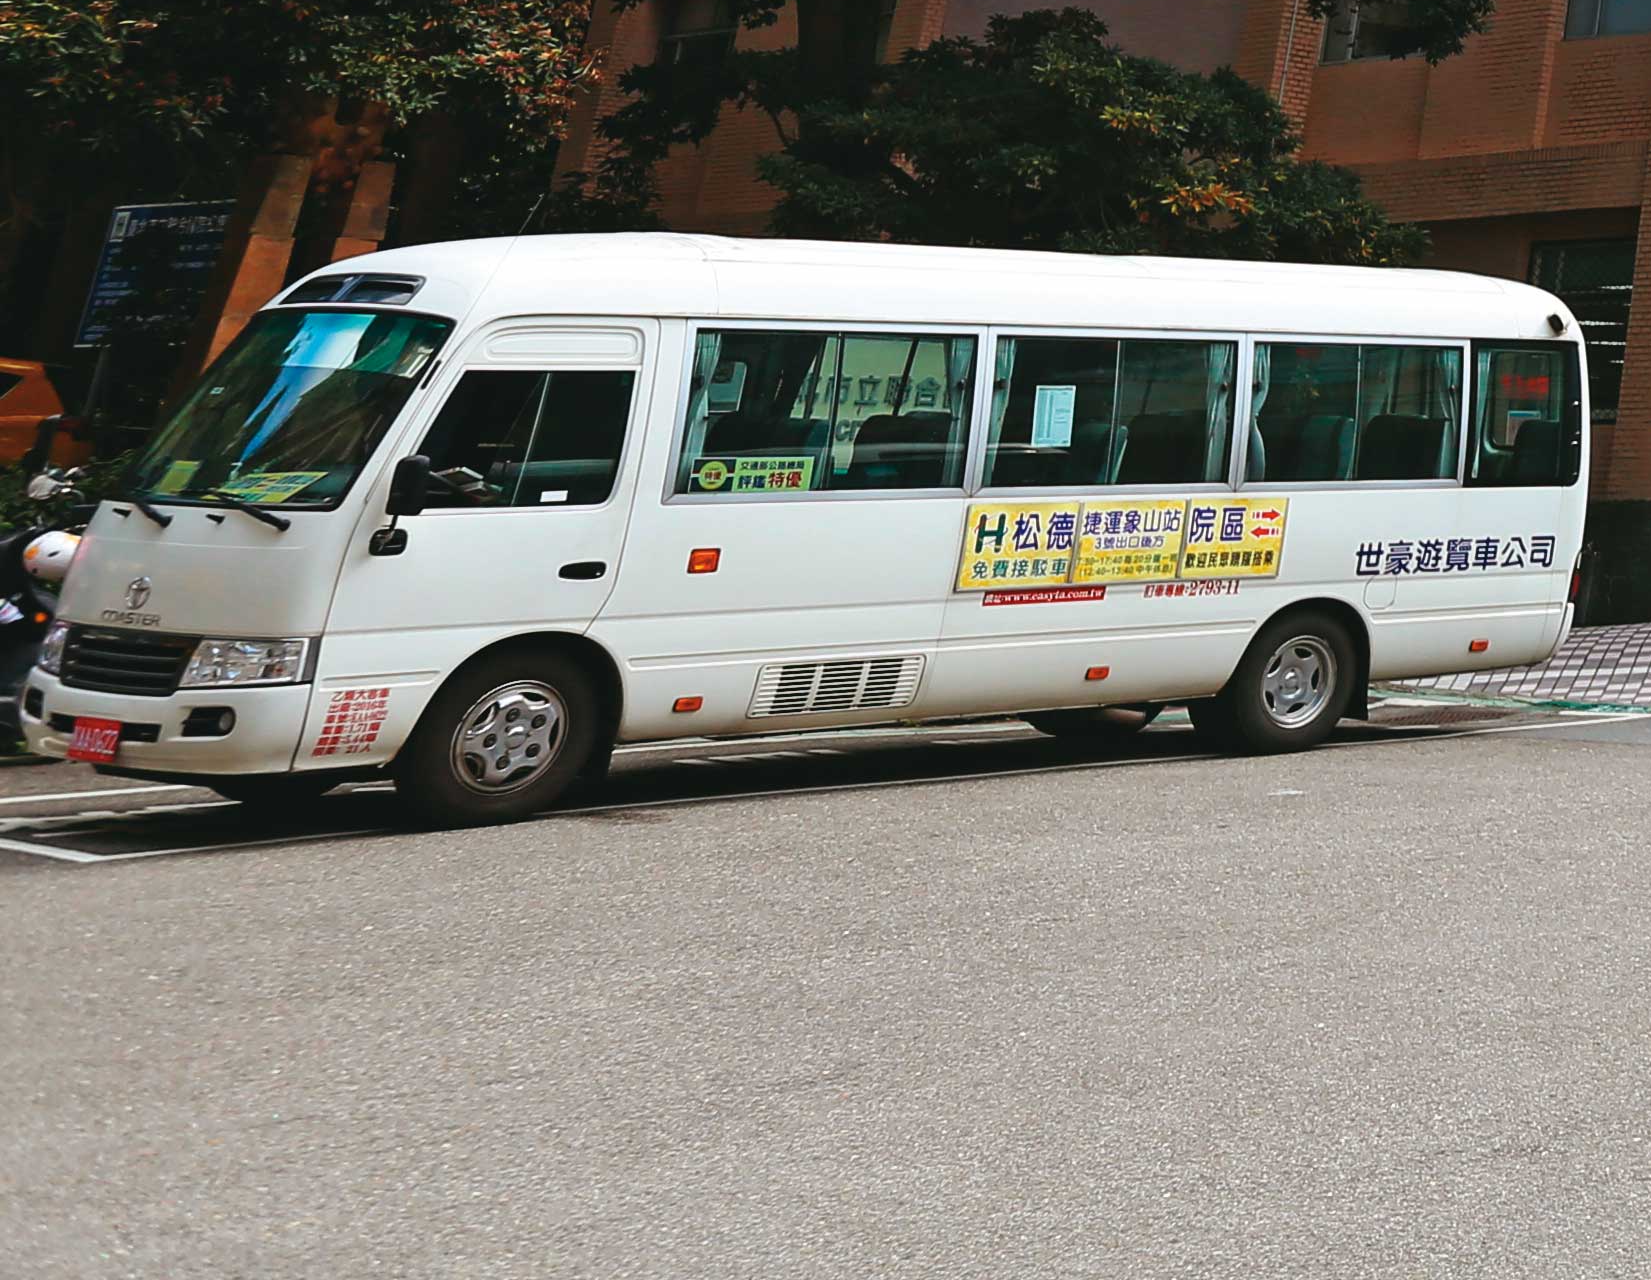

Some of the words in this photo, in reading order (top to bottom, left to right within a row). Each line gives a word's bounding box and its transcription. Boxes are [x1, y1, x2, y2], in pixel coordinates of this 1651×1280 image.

[1012, 512, 1076, 552] 松德
[1082, 509, 1181, 536] 捷運象山站
[1188, 506, 1247, 544] 院區
[971, 558, 1069, 580] 免費接駁車
[1355, 536, 1556, 576] 世豪遊覽車公司
